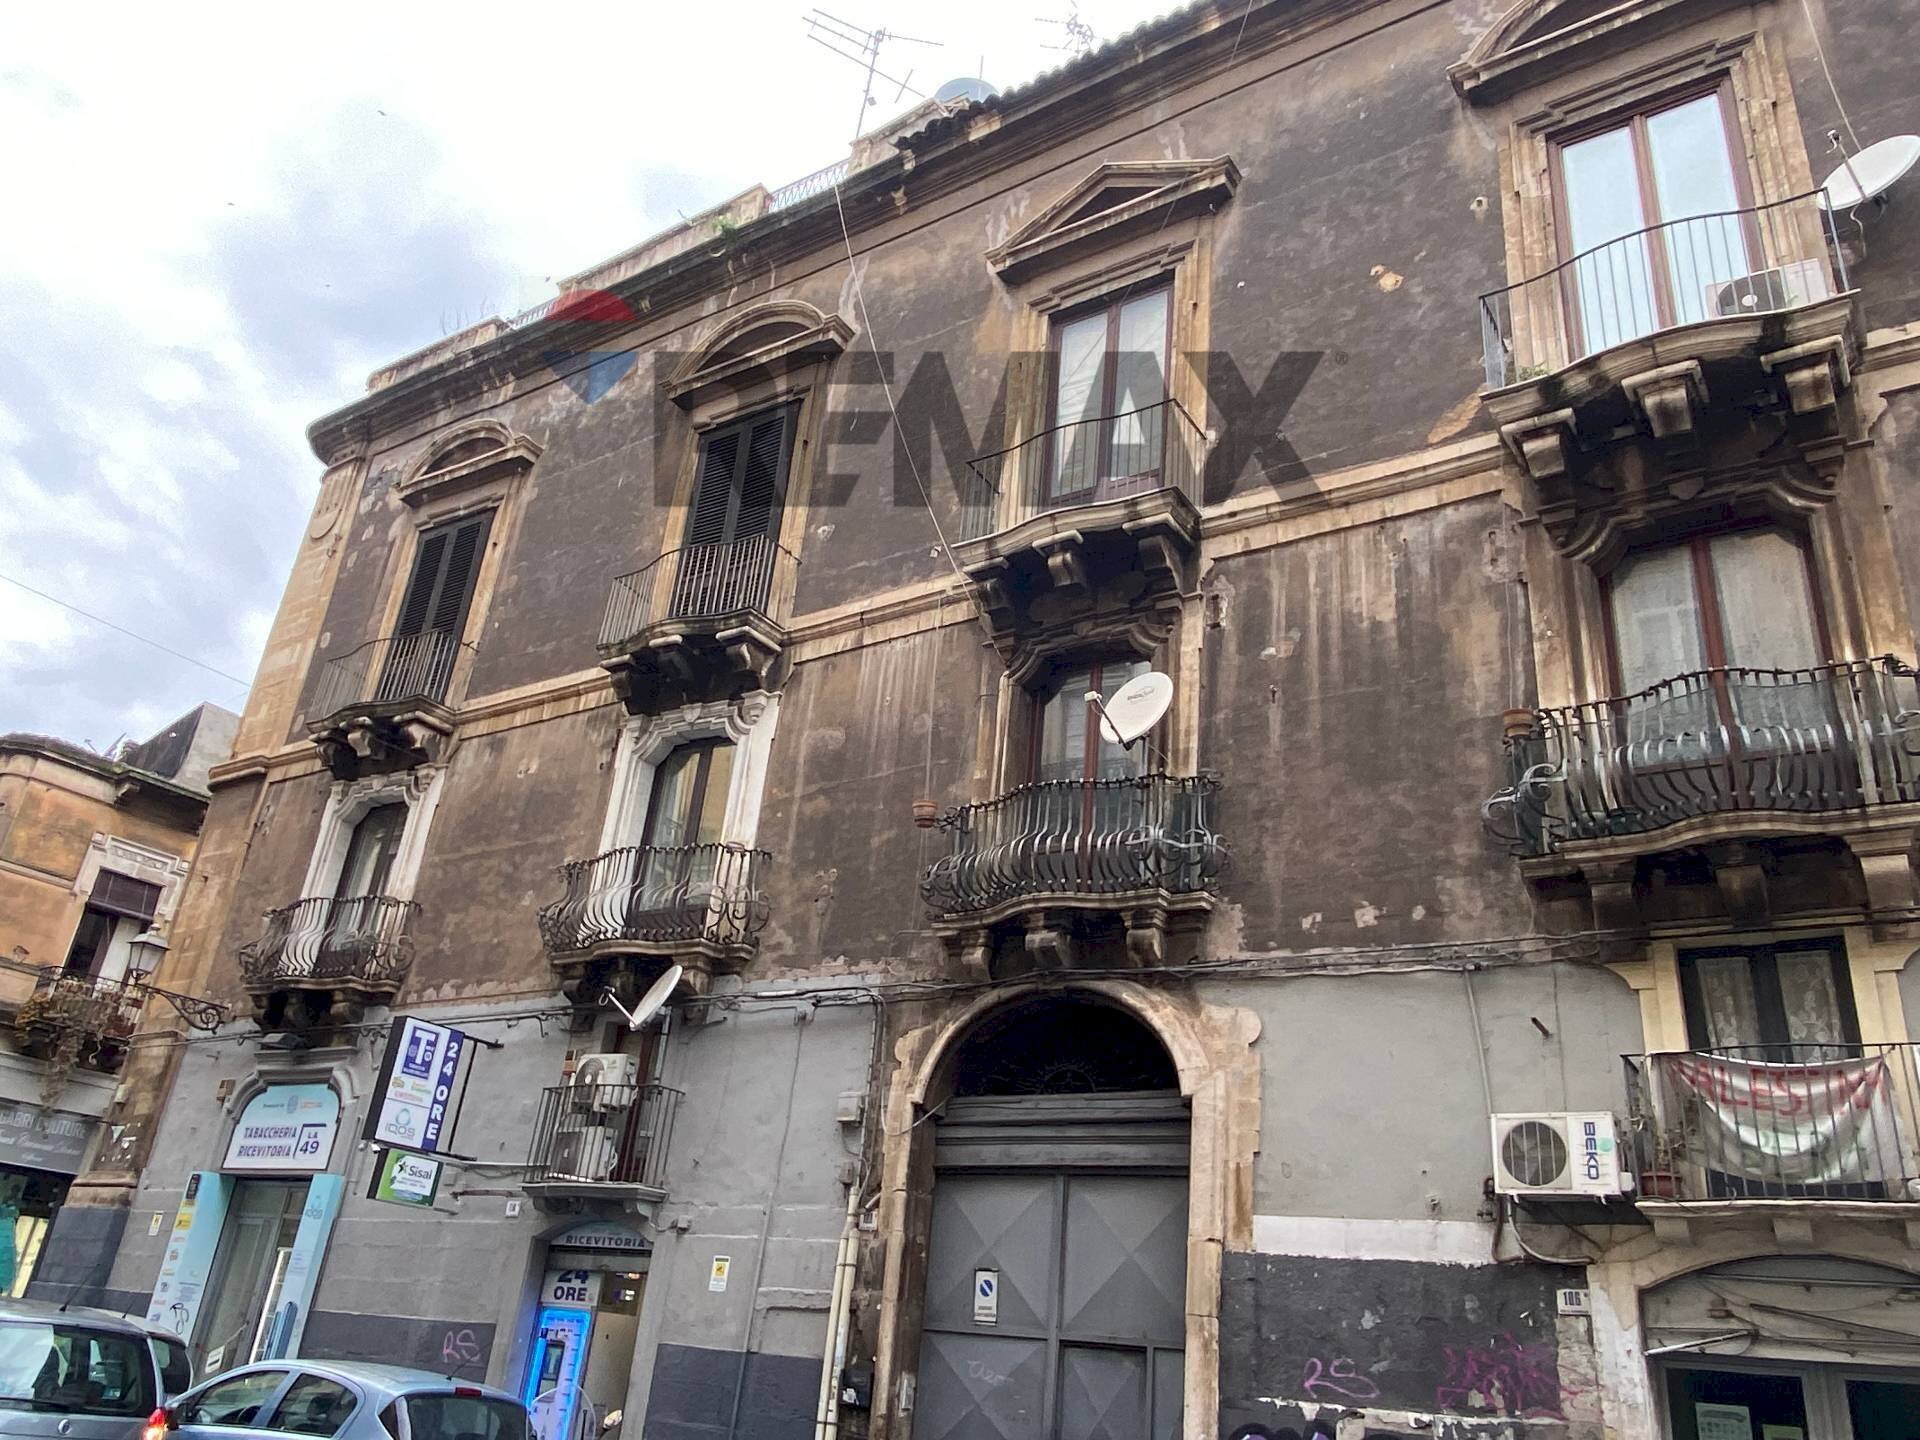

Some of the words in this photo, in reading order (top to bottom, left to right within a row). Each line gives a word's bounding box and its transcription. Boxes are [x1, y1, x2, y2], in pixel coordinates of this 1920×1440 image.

[442, 1042, 459, 1077] 24
[425, 1086, 449, 1140] ORE
[243, 1126, 297, 1138] TABACCHERIA
[307, 1131, 318, 1139] LA
[237, 1144, 292, 1157] RICEVITORIA
[299, 1140, 320, 1155] 49
[1583, 1121, 1600, 1180] BEKO
[408, 1165, 433, 1180] Sisal
[565, 1234, 645, 1248] RICEVITORIA
[557, 1269, 589, 1284] 24
[553, 1285, 588, 1302] ORE
[1563, 1290, 1582, 1306] 106
